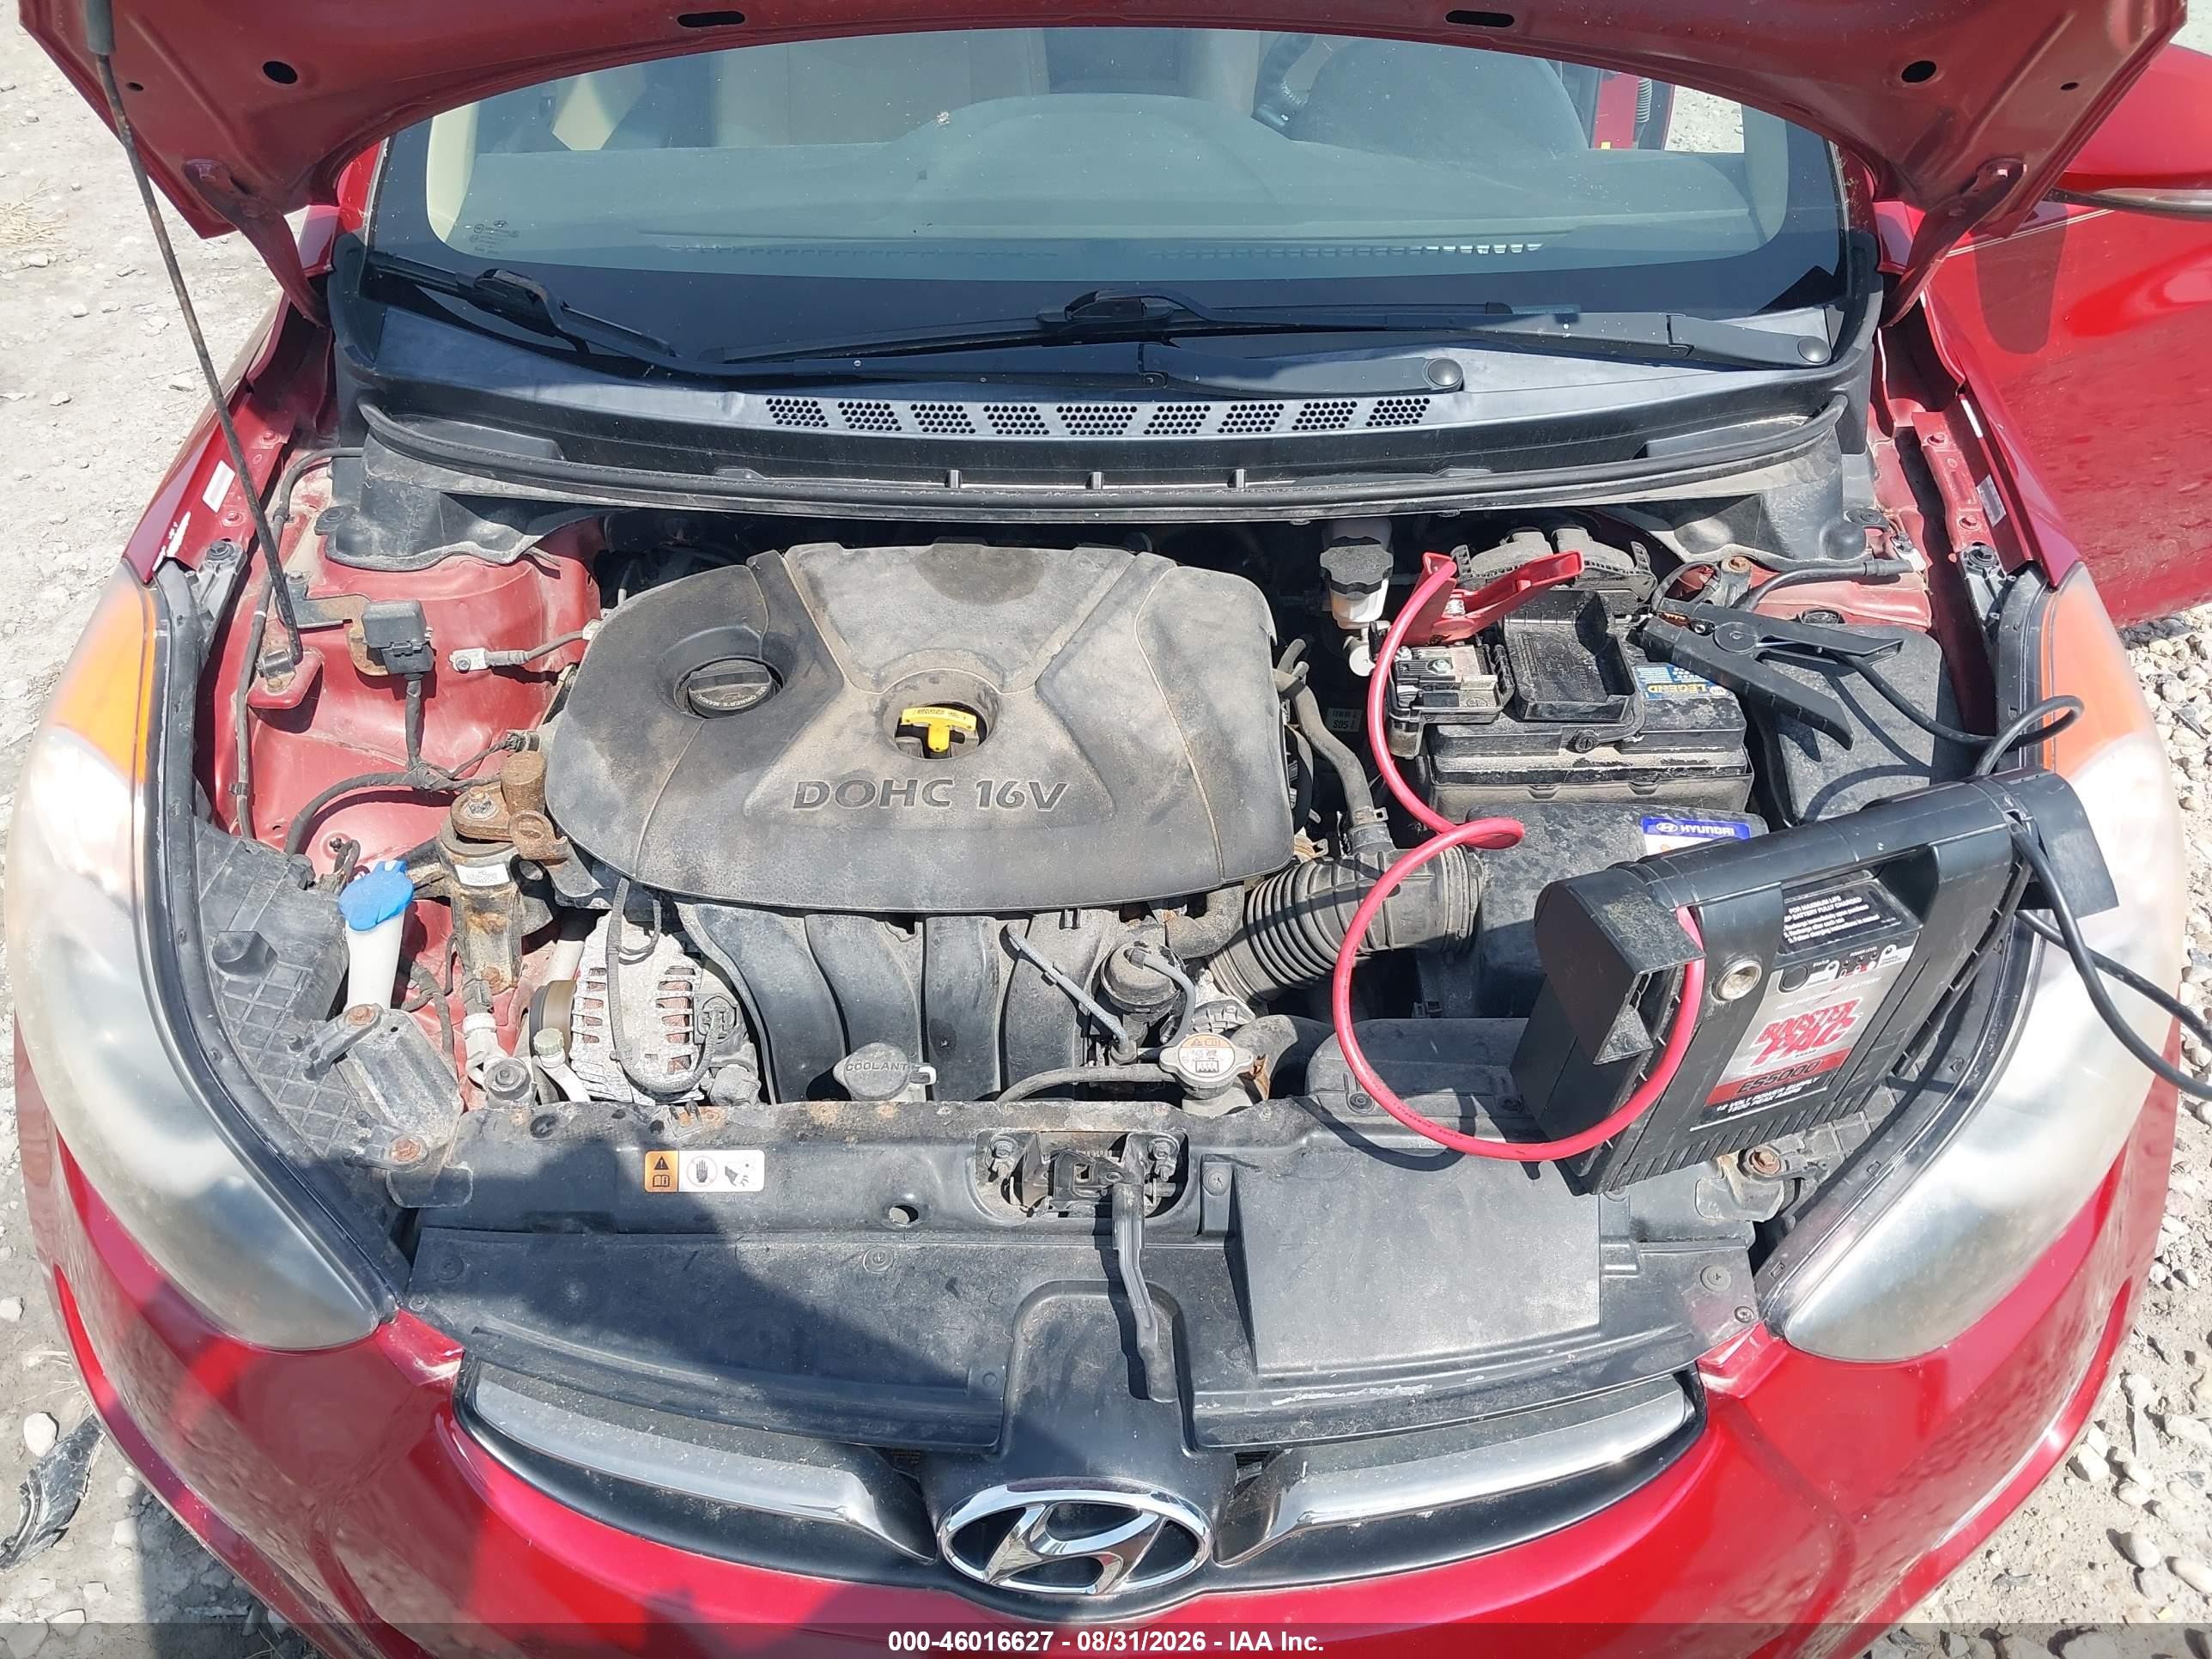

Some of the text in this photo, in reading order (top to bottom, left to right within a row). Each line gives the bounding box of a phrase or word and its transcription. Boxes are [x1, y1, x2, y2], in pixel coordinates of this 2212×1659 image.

[1647, 684, 1707, 693] LEGEND
[723, 694, 757, 707] OWNER'S
[793, 779, 1067, 811] DOHC 16V
[1680, 824, 1735, 836] HYUNDAI
[1789, 895, 1842, 915] FOR MAXIMUM LIFE
[1792, 908, 1817, 920] BATTERY
[1817, 903, 1835, 913] FULLY
[1834, 896, 1863, 908] CHARGED
[1752, 997, 1862, 1048] BOOSTER
[1750, 1017, 1857, 1068] PAC
[846, 1062, 908, 1072] COOLANT
[1737, 1060, 1822, 1093] ES5000
[1729, 1097, 1752, 1109] VOLT
[1751, 1086, 1786, 1101] POWER
[1784, 1076, 1821, 1090] SUPPLY
[1750, 1094, 1777, 1107] PEAK
[1775, 1086, 1802, 1099] AMPS
